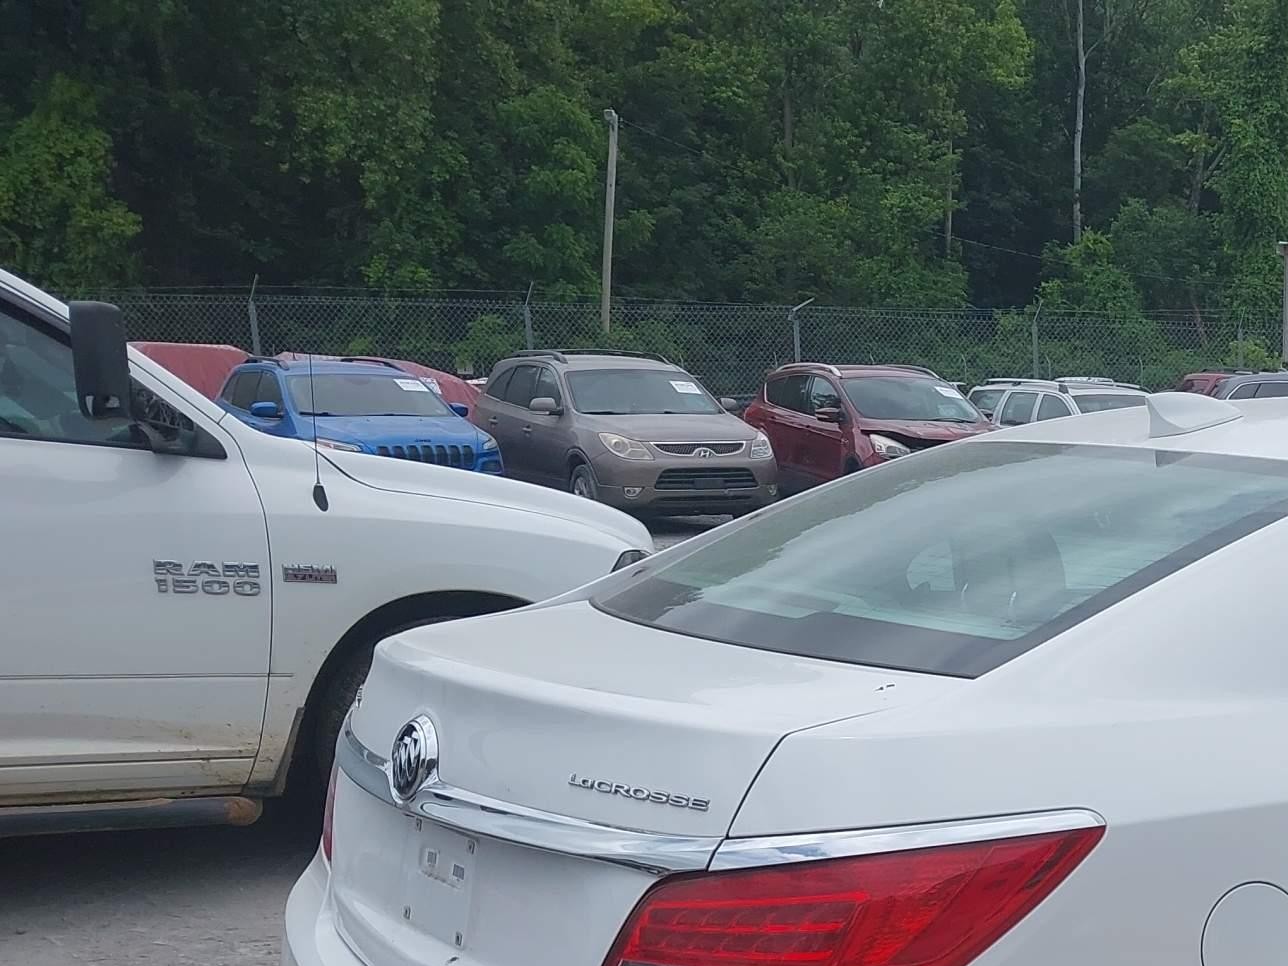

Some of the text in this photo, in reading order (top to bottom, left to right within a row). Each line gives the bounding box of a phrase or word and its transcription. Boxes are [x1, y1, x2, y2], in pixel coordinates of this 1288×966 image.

[153, 559, 260, 578] RAM
[154, 577, 261, 596] 1500
[568, 772, 711, 812] LaCROSSE
